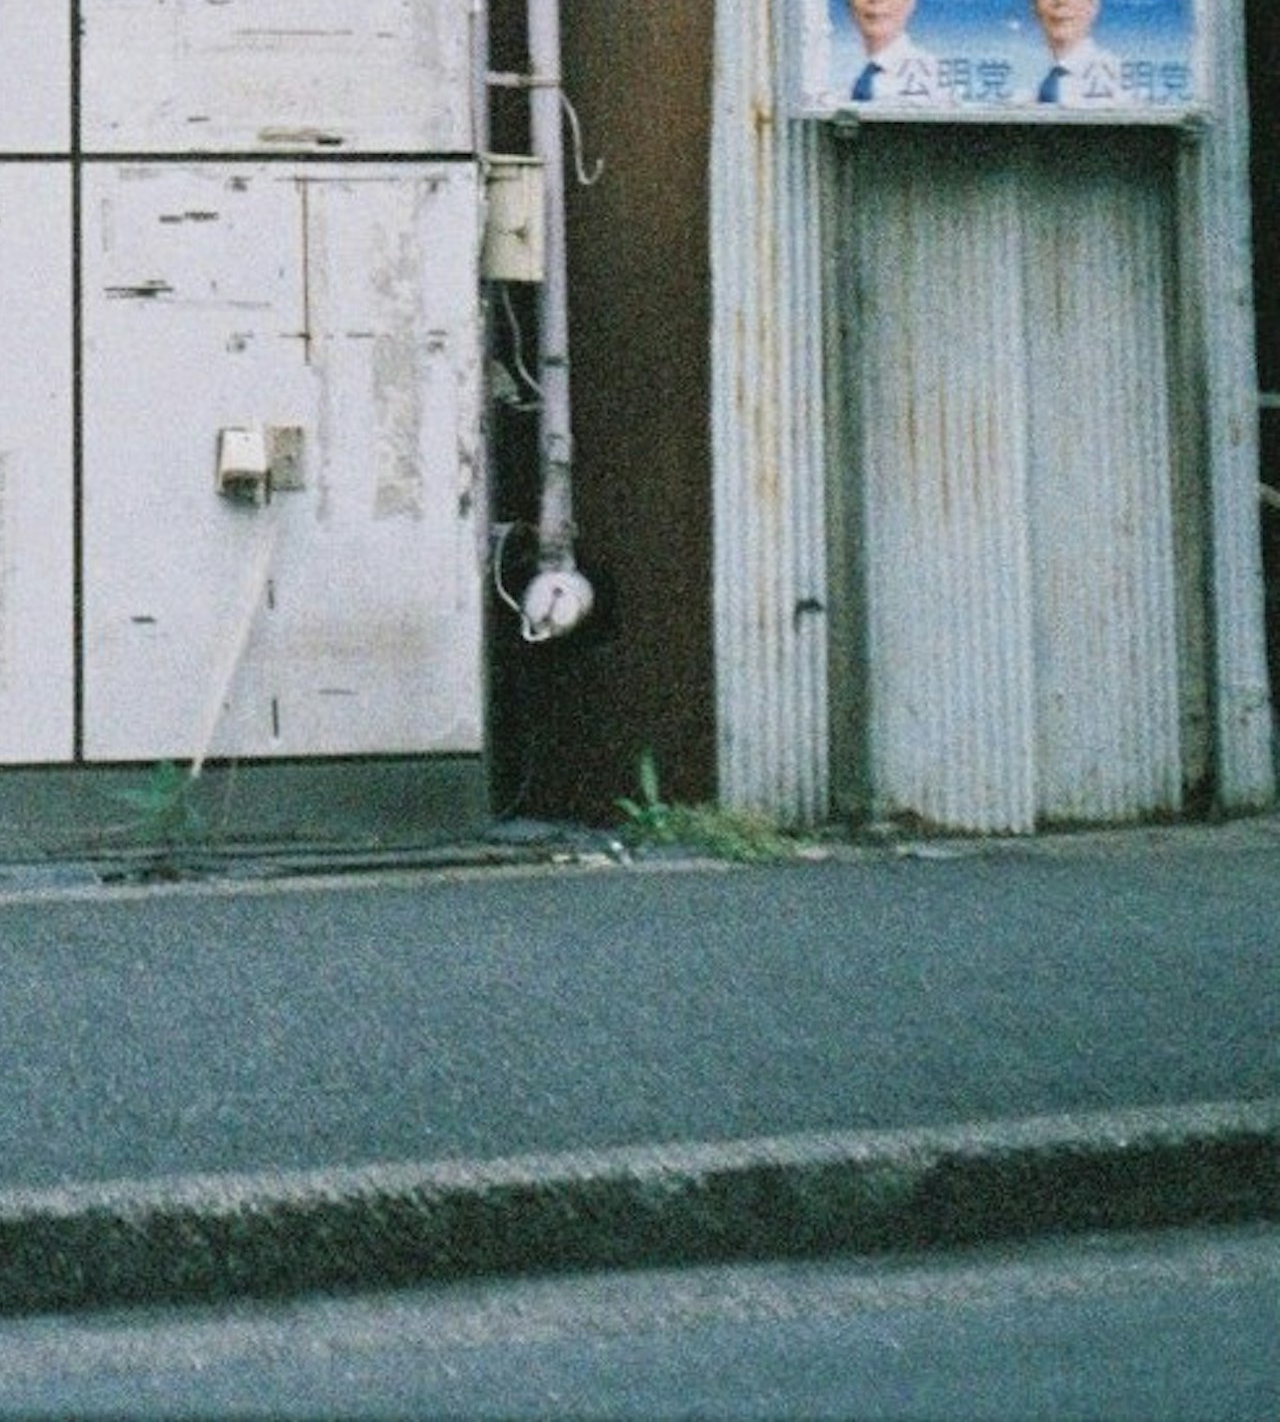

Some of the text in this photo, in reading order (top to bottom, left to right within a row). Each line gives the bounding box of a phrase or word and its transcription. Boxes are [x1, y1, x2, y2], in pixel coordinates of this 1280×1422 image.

[897, 56, 1011, 100] 公明党
[1081, 60, 1195, 102] 公明党
